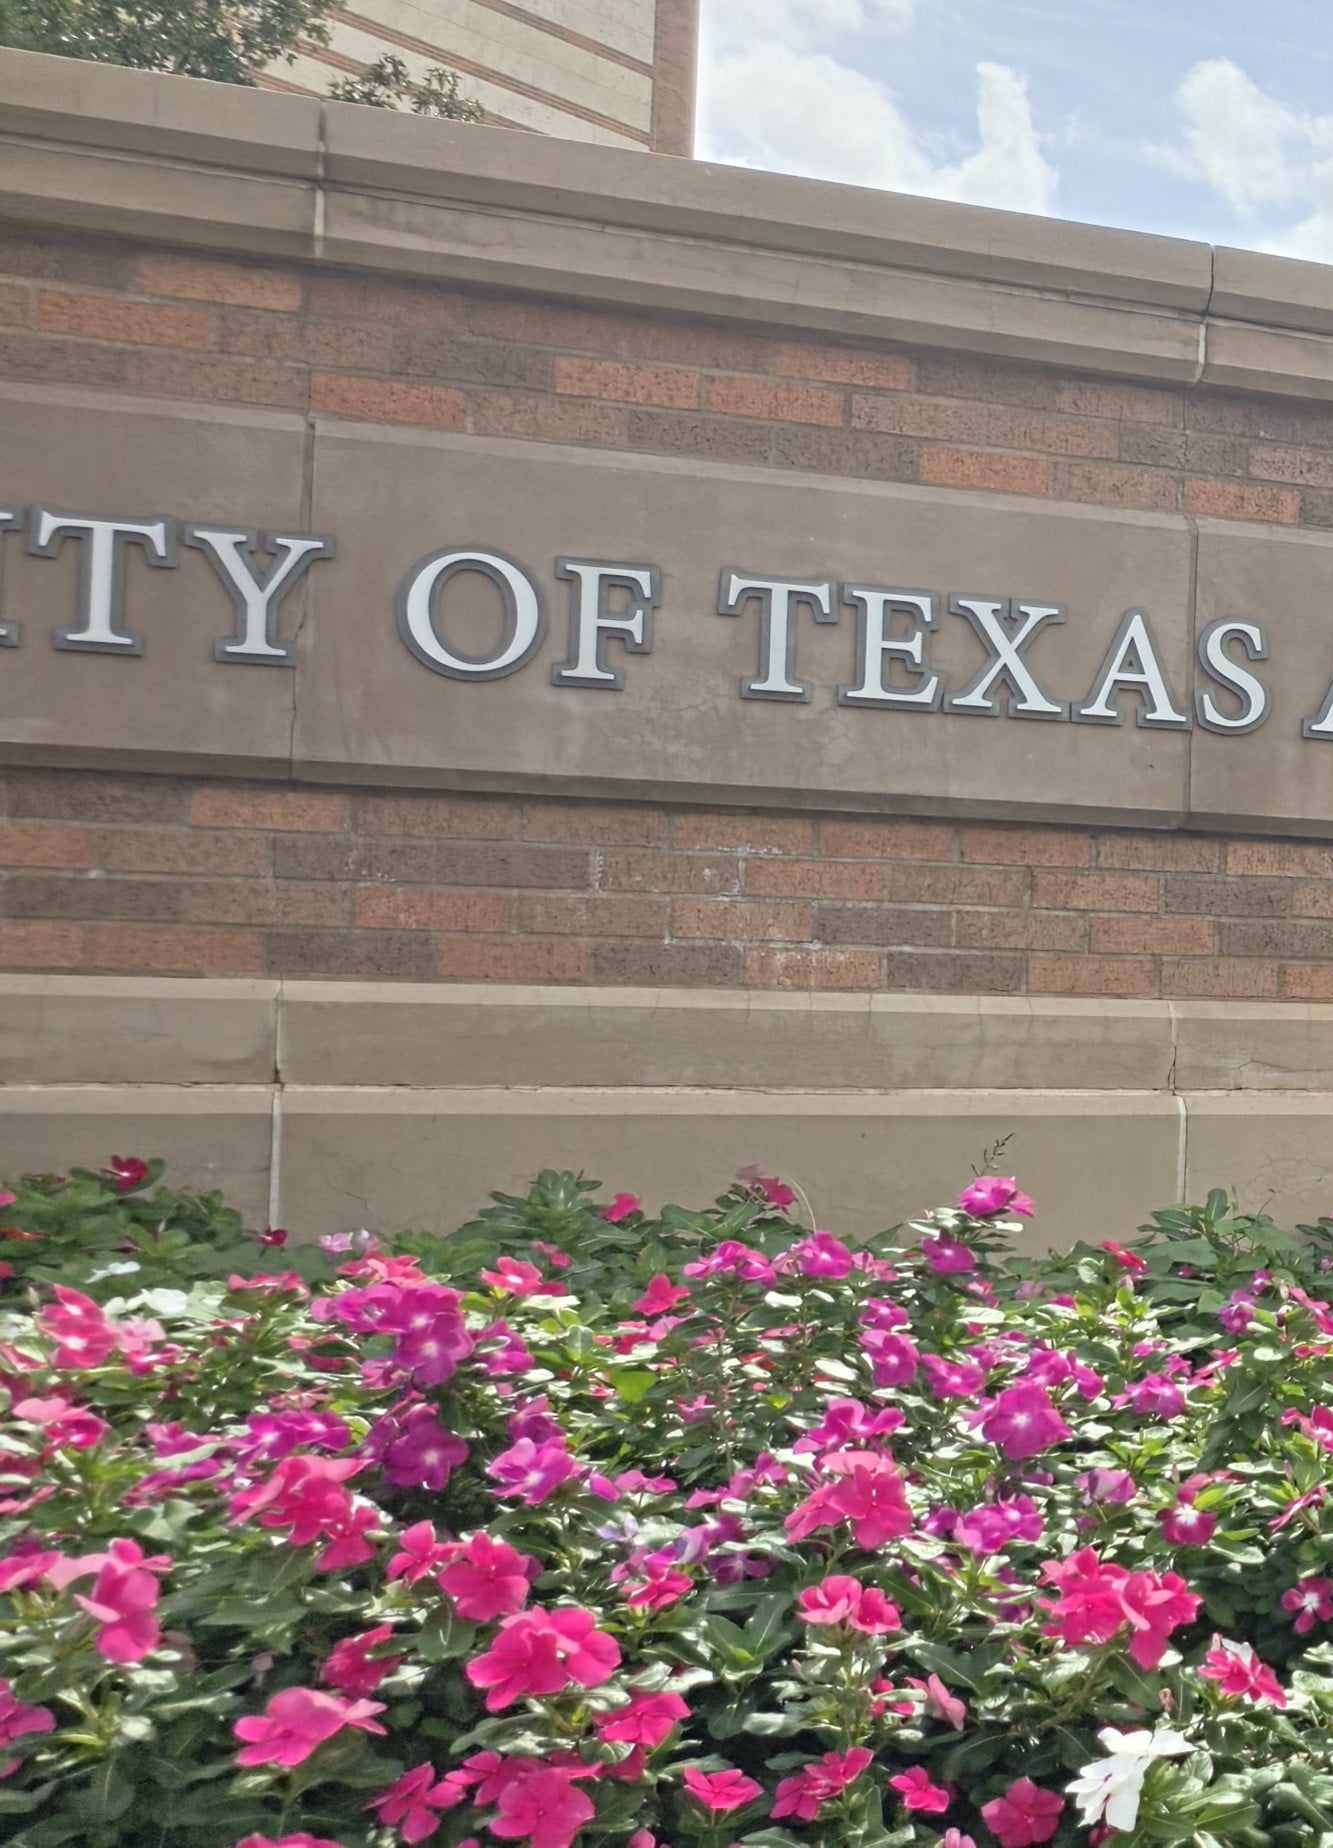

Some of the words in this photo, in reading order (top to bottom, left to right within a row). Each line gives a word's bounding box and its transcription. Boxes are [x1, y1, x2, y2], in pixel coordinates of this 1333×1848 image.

[0, 507, 329, 662] TY
[402, 549, 656, 685] OF
[723, 571, 1268, 731] TEXAS
